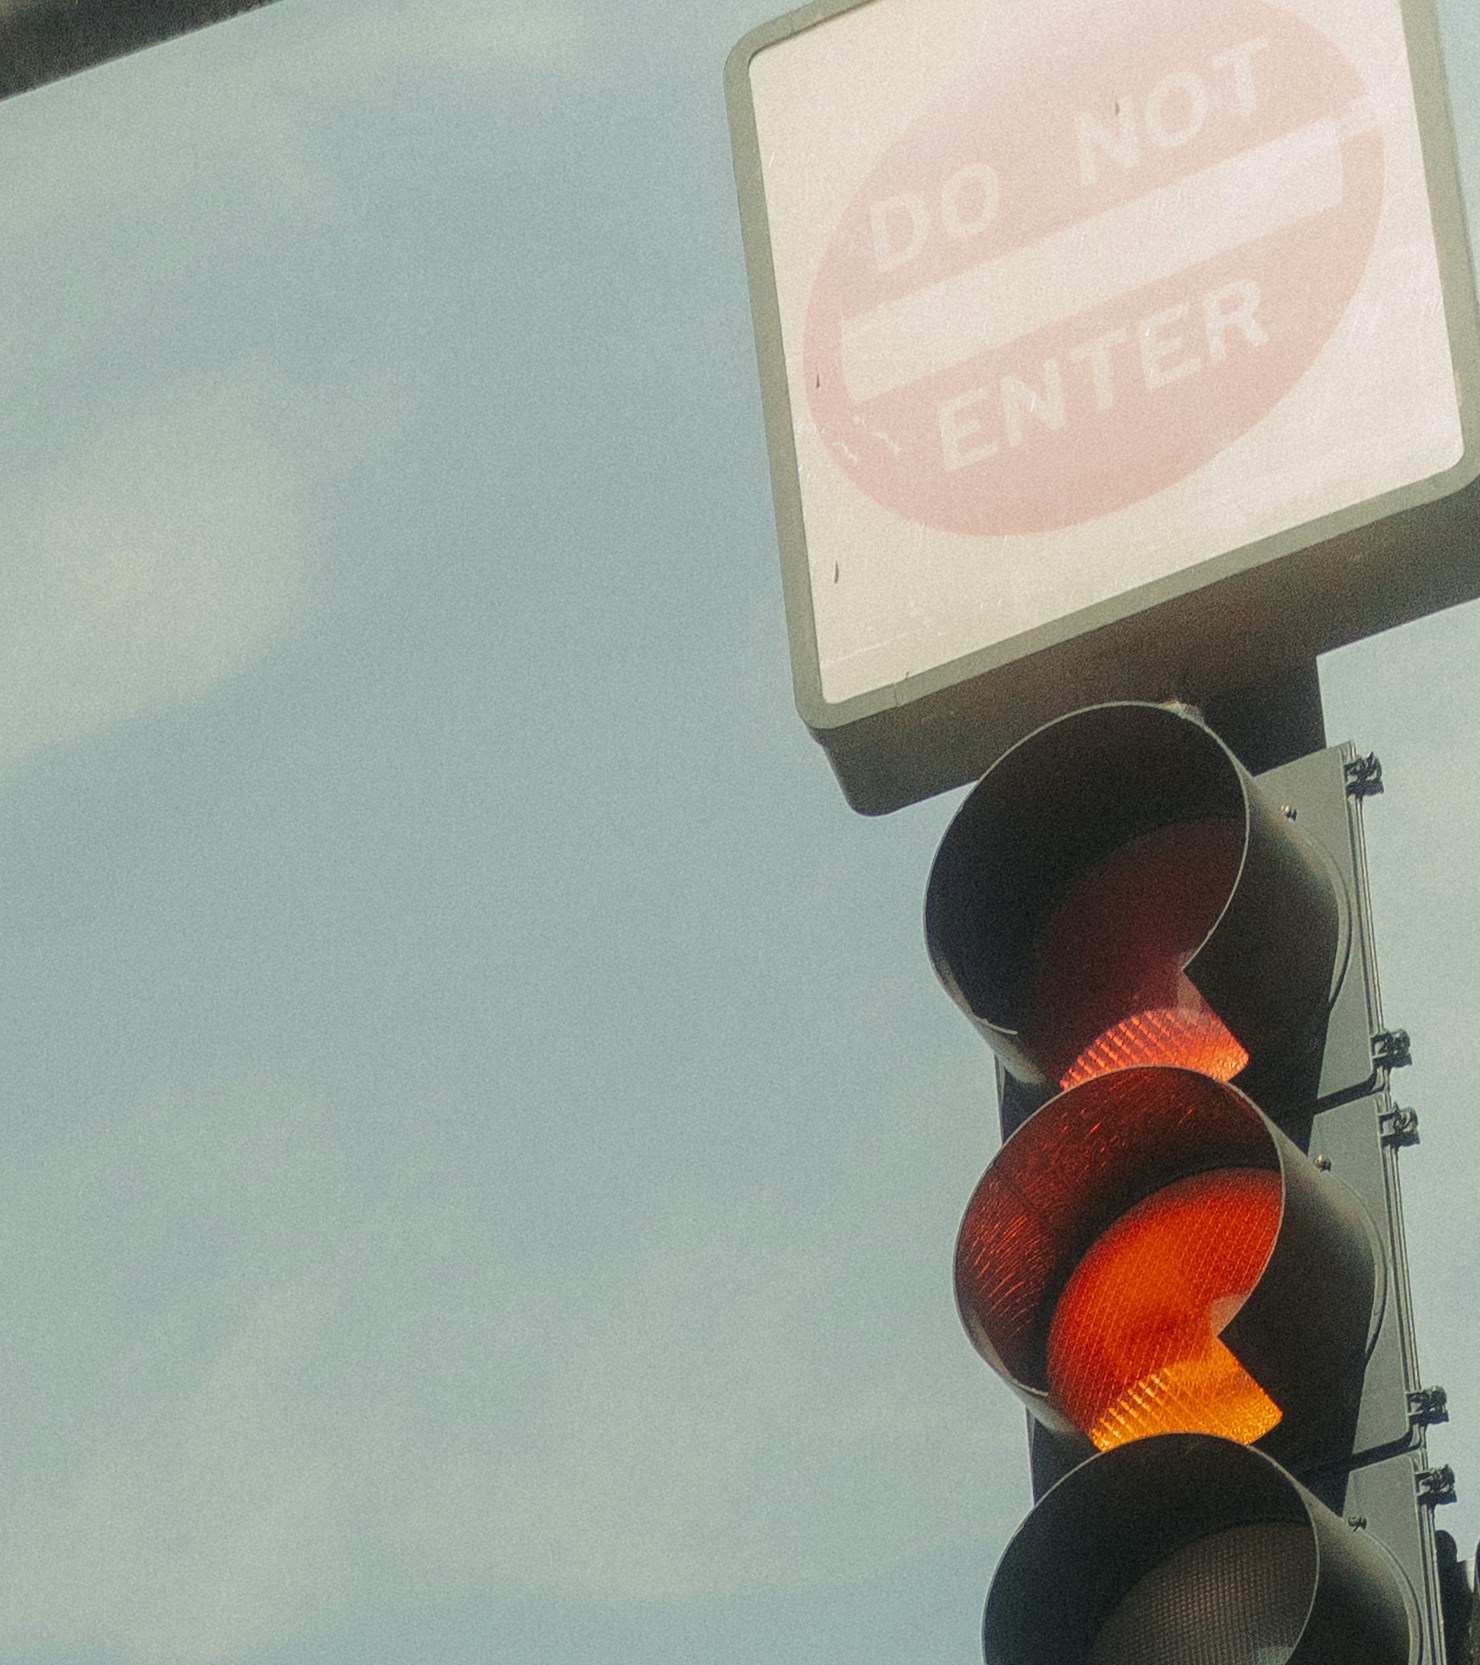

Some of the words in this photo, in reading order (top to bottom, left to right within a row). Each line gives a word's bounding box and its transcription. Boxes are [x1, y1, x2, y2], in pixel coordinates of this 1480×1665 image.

[869, 161, 1000, 274] DO
[1073, 36, 1270, 189] NOT
[938, 278, 1271, 474] ENTER
